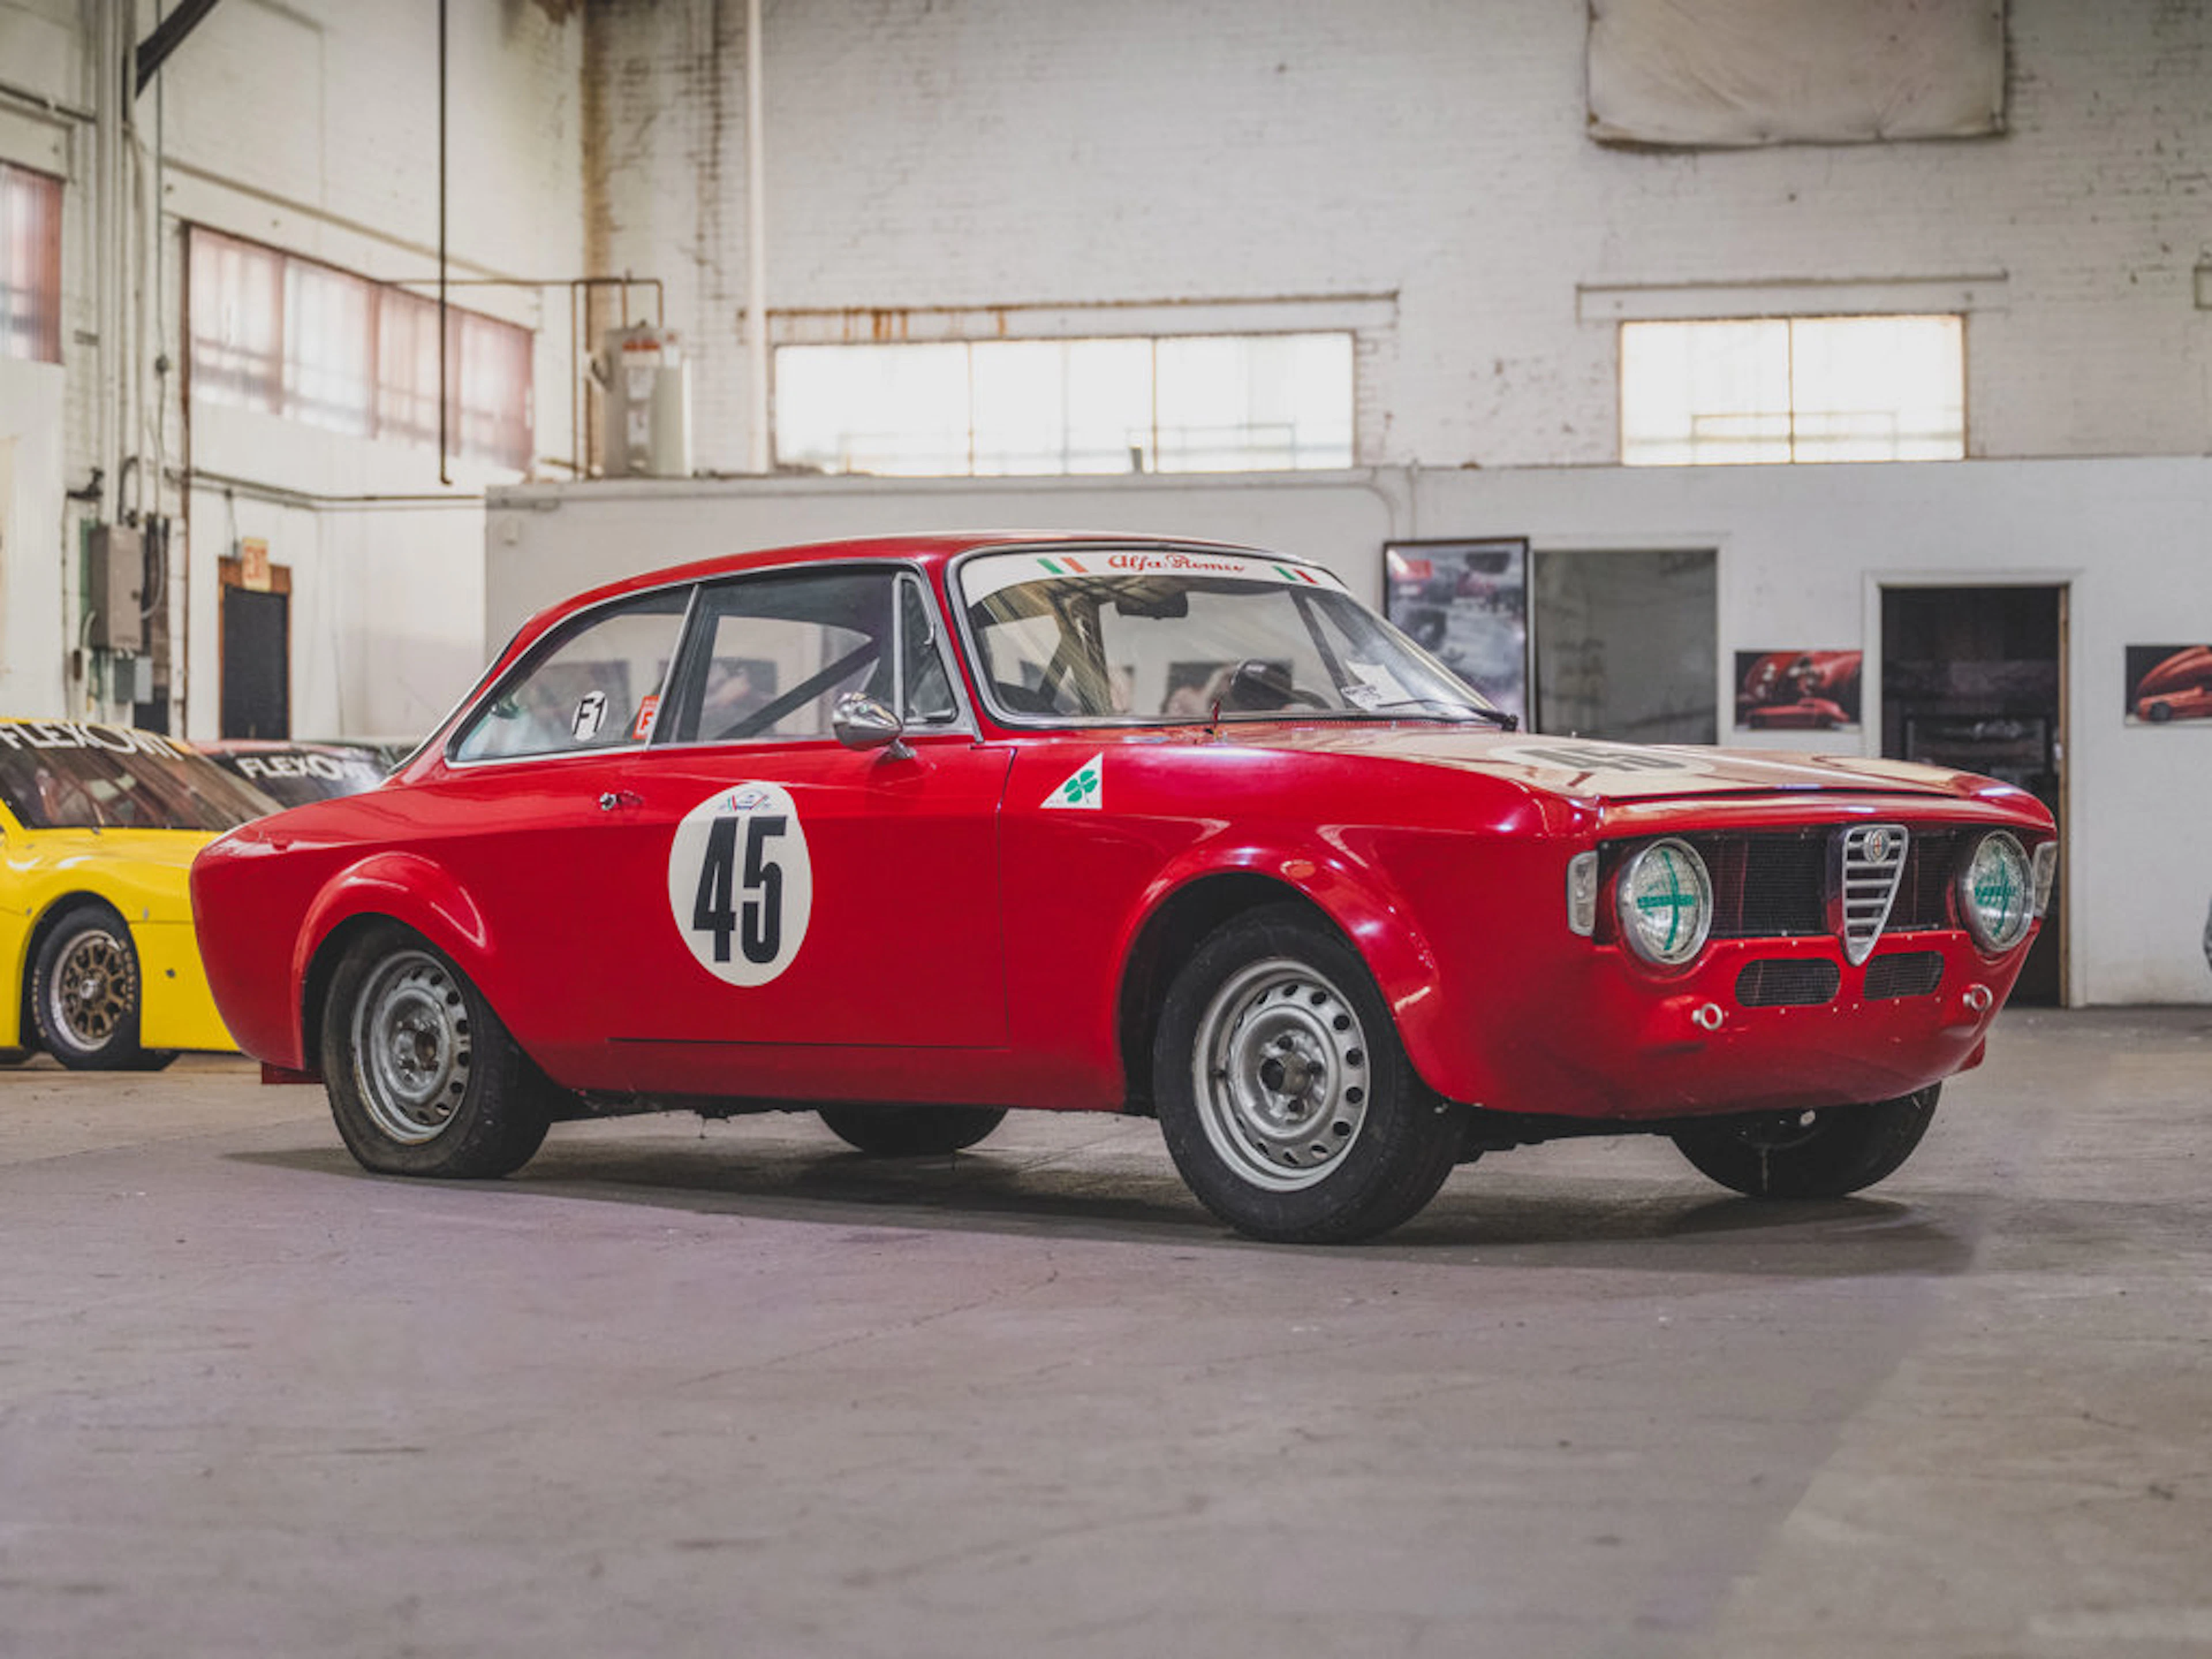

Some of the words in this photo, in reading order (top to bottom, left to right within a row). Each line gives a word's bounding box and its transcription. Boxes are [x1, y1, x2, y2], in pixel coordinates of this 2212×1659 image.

[1108, 554, 1161, 571] Alfa
[1164, 554, 1245, 571] Romeo
[573, 698, 605, 734] F1
[692, 815, 787, 963] 45
